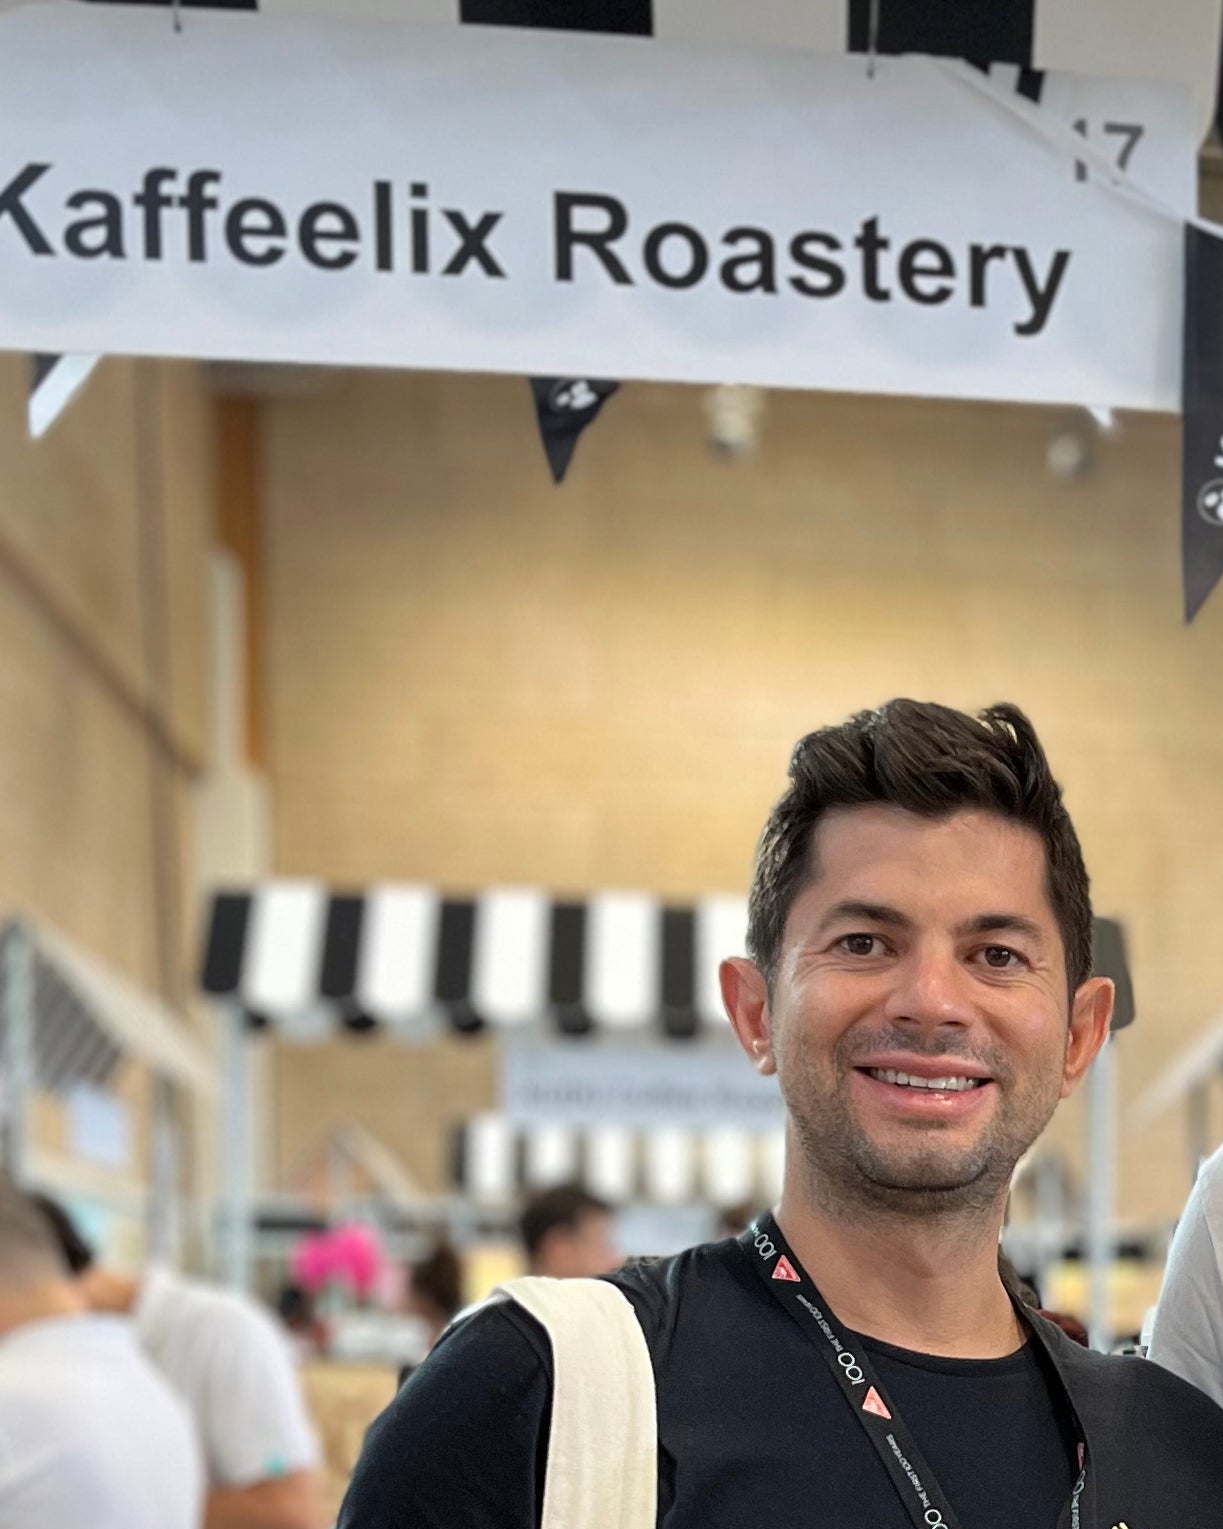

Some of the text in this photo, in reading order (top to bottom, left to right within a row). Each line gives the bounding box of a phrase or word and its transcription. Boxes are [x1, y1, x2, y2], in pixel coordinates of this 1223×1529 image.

[0, 162, 1072, 338] Kaffeelix Roastery
[838, 1352, 866, 1384] 100
[886, 1434, 902, 1458] YEARS
